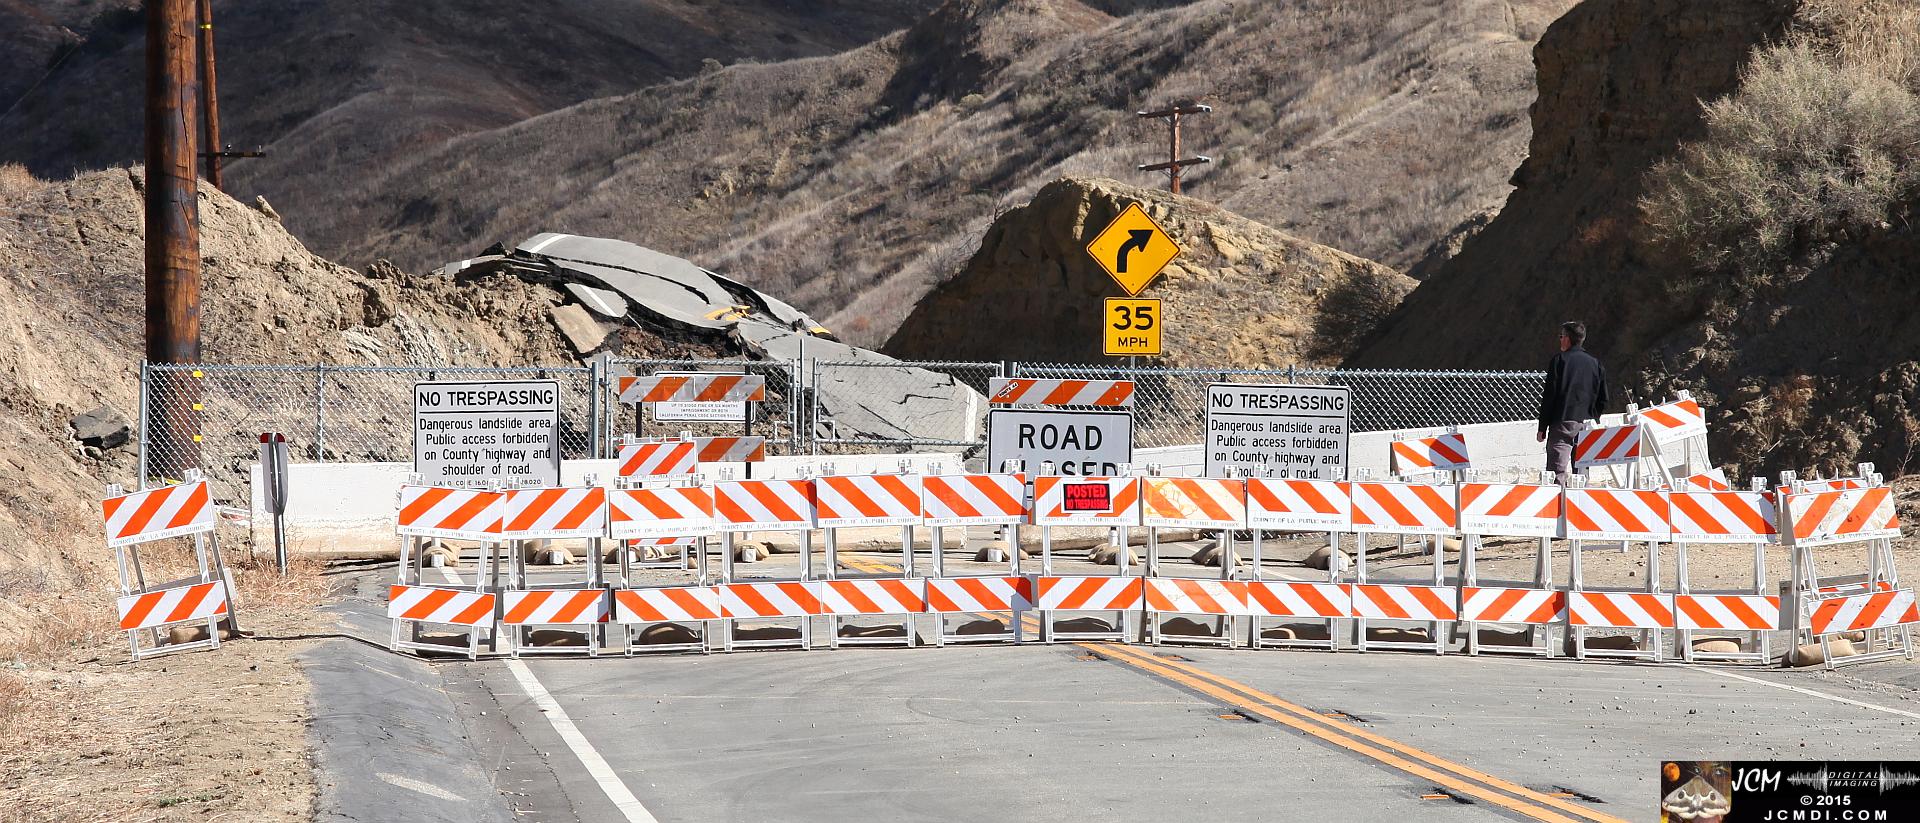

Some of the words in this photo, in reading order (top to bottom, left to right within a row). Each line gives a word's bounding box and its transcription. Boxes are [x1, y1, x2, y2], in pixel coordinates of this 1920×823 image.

[1112, 306, 1154, 330] 35
[1118, 337, 1148, 347] MPH
[419, 392, 440, 406] NO
[447, 390, 554, 406] TRESPASSING
[1212, 393, 1234, 408] NO
[1240, 394, 1344, 410] TRESPASSING
[420, 418, 472, 433] Dangerous
[480, 418, 522, 429] landslide
[528, 419, 553, 428] area.
[1211, 420, 1264, 434] Dangerous
[1270, 422, 1312, 433] landslide
[1319, 424, 1343, 434] area.
[426, 434, 456, 445] Public
[462, 436, 496, 444] access
[502, 433, 548, 444] forbidden
[1018, 424, 1102, 450] ROAD
[1216, 435, 1246, 446] Public
[1252, 438, 1286, 448] access
[1292, 437, 1338, 449] forbidden
[424, 451, 436, 460] on
[442, 449, 479, 462] County
[486, 448, 526, 462] highway
[532, 448, 551, 459] and
[1214, 452, 1226, 461] on
[1232, 450, 1268, 464] County
[1274, 452, 1315, 466] highway
[1322, 454, 1340, 464] and
[442, 464, 485, 475] shoulder
[492, 464, 501, 474] of
[508, 464, 532, 474] road.
[1296, 468, 1320, 478] road.
[1066, 485, 1106, 498] POSTED
[1066, 500, 1074, 508] NO
[1074, 499, 1109, 509] TRESPASSING
